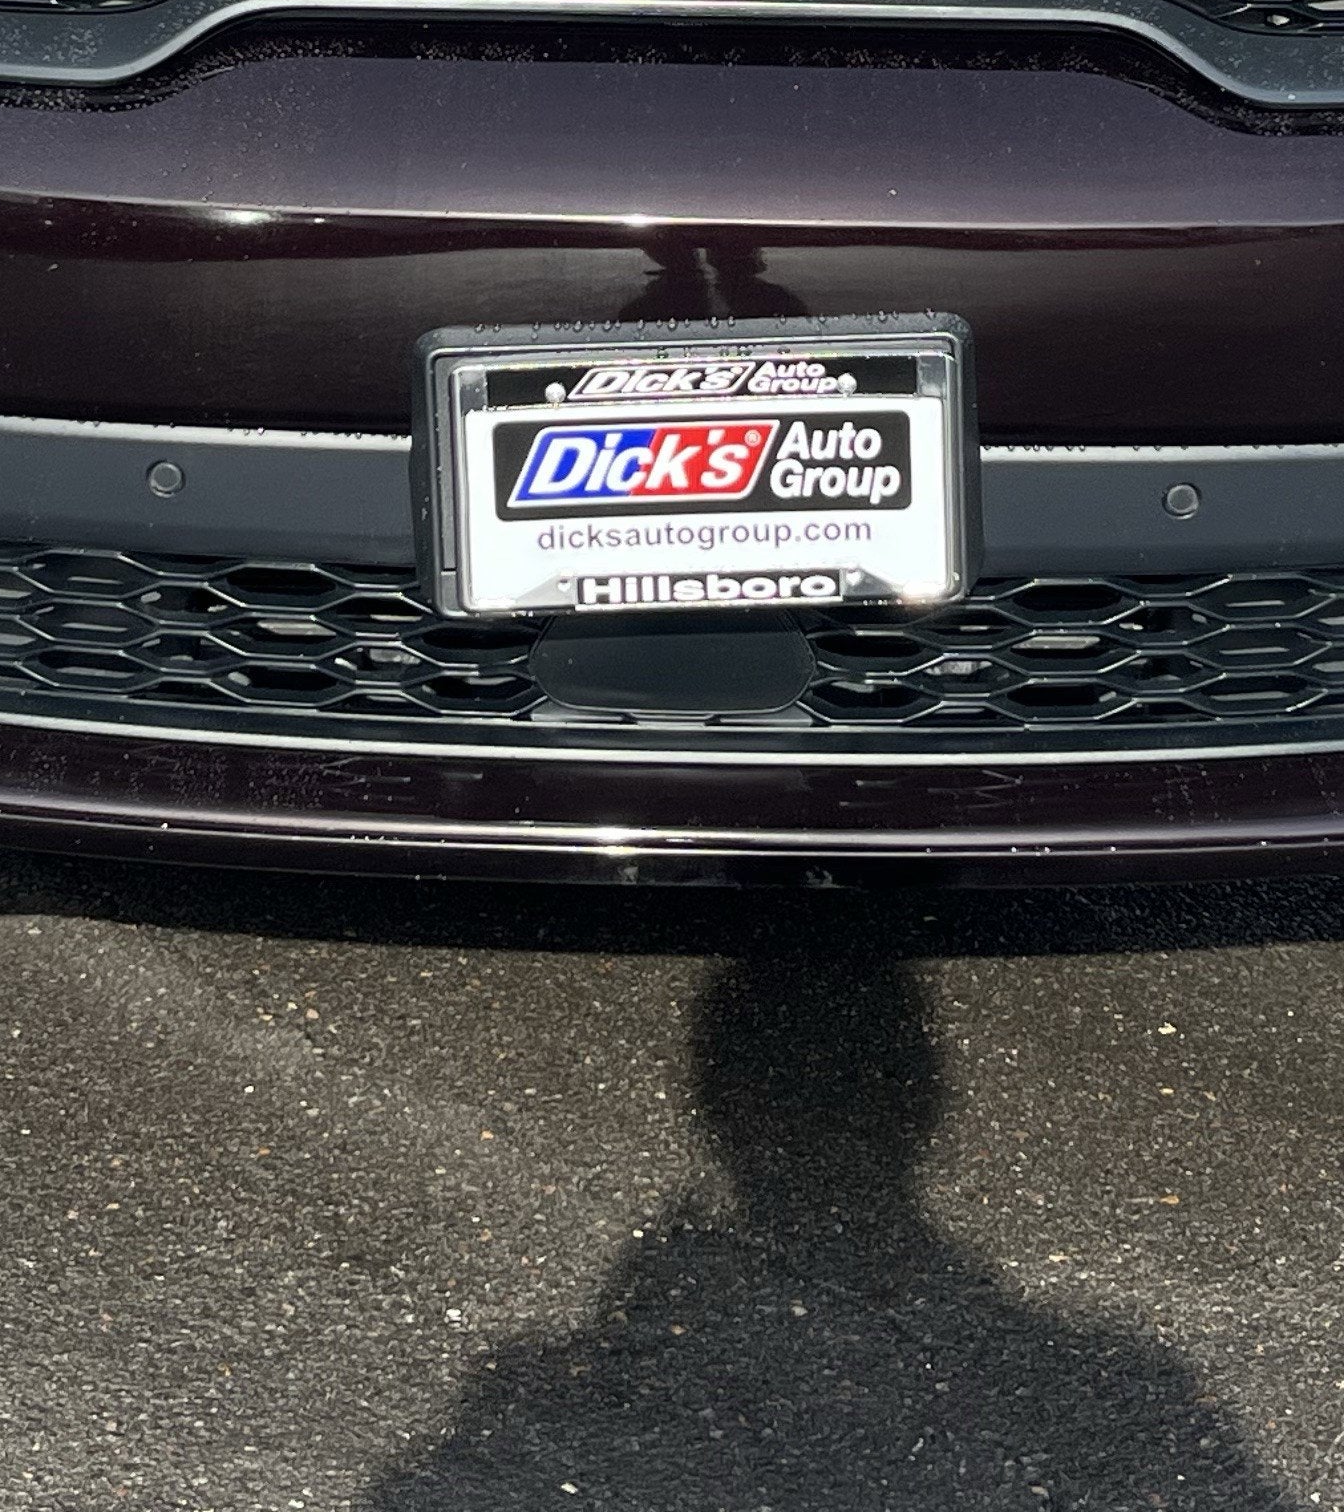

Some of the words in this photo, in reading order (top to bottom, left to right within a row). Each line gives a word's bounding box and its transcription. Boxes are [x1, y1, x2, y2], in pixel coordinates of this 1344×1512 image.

[754, 361, 826, 378] Auto
[747, 376, 838, 394] Group
[776, 421, 882, 461] Auto
[527, 429, 750, 495] Dick's
[769, 458, 902, 505] Group
[537, 521, 873, 551] dicksautogroup.com
[581, 574, 838, 604] Hillsboro
